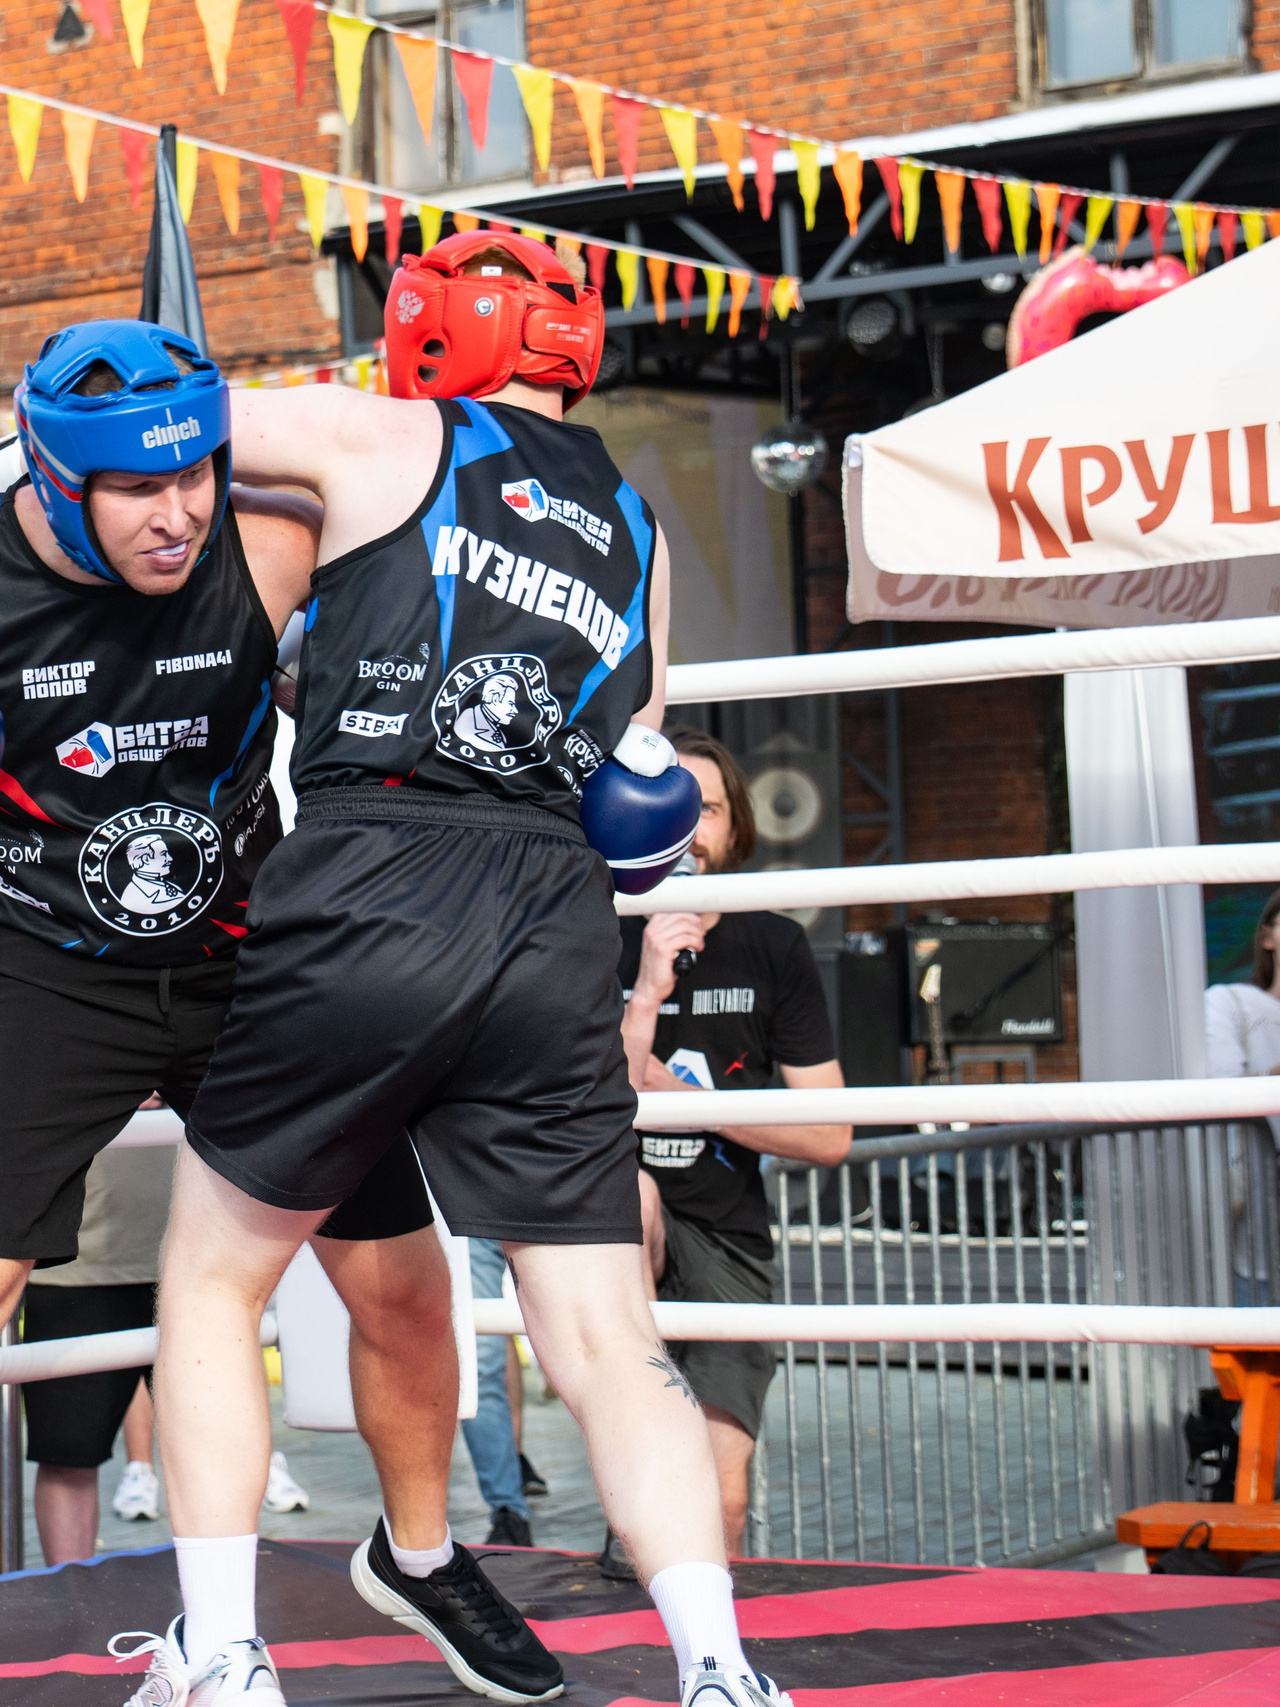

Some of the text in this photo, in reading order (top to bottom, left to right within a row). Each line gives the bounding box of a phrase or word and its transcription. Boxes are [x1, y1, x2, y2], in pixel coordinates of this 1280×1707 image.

[142, 411, 202, 450] clinch
[548, 496, 613, 545] БИТВА
[431, 525, 630, 671] КУЗНЕЦОВ
[22, 660, 96, 685] ВИКТОР
[358, 660, 428, 682] BROOM
[376, 681, 401, 693] GIN
[23, 678, 88, 700] ПОПОВ
[115, 715, 209, 750] БИТВА
[441, 733, 517, 768] 2010
[84, 808, 221, 884] КАНЦЛЕРЪ
[114, 895, 203, 930] 2010
